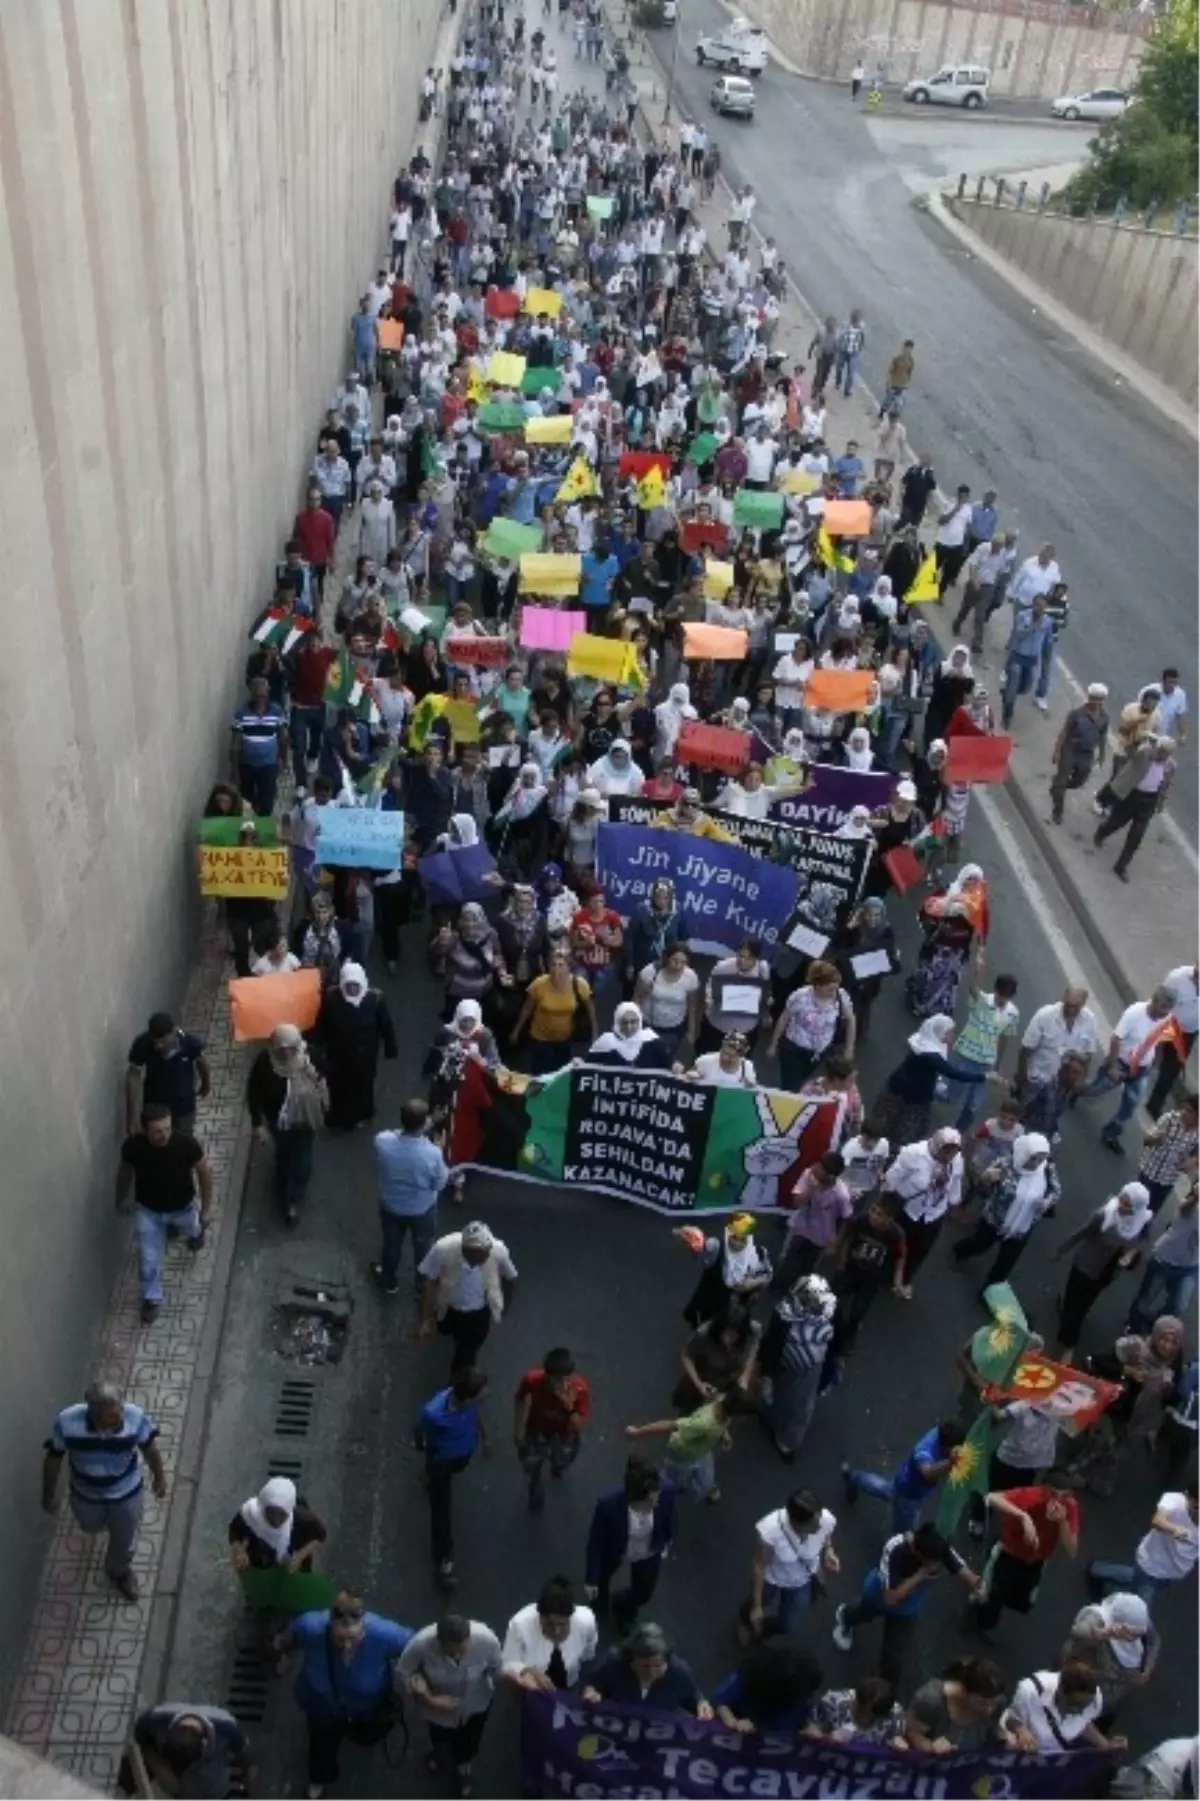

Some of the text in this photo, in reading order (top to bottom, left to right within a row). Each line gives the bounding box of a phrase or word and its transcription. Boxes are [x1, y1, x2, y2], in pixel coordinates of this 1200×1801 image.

[683, 890, 718, 915] Ne
[577, 1073, 707, 1111] FİLİSTİN'DE
[592, 1095, 685, 1133] İNTİFİDA
[578, 1119, 692, 1160] ROJAVA'DA
